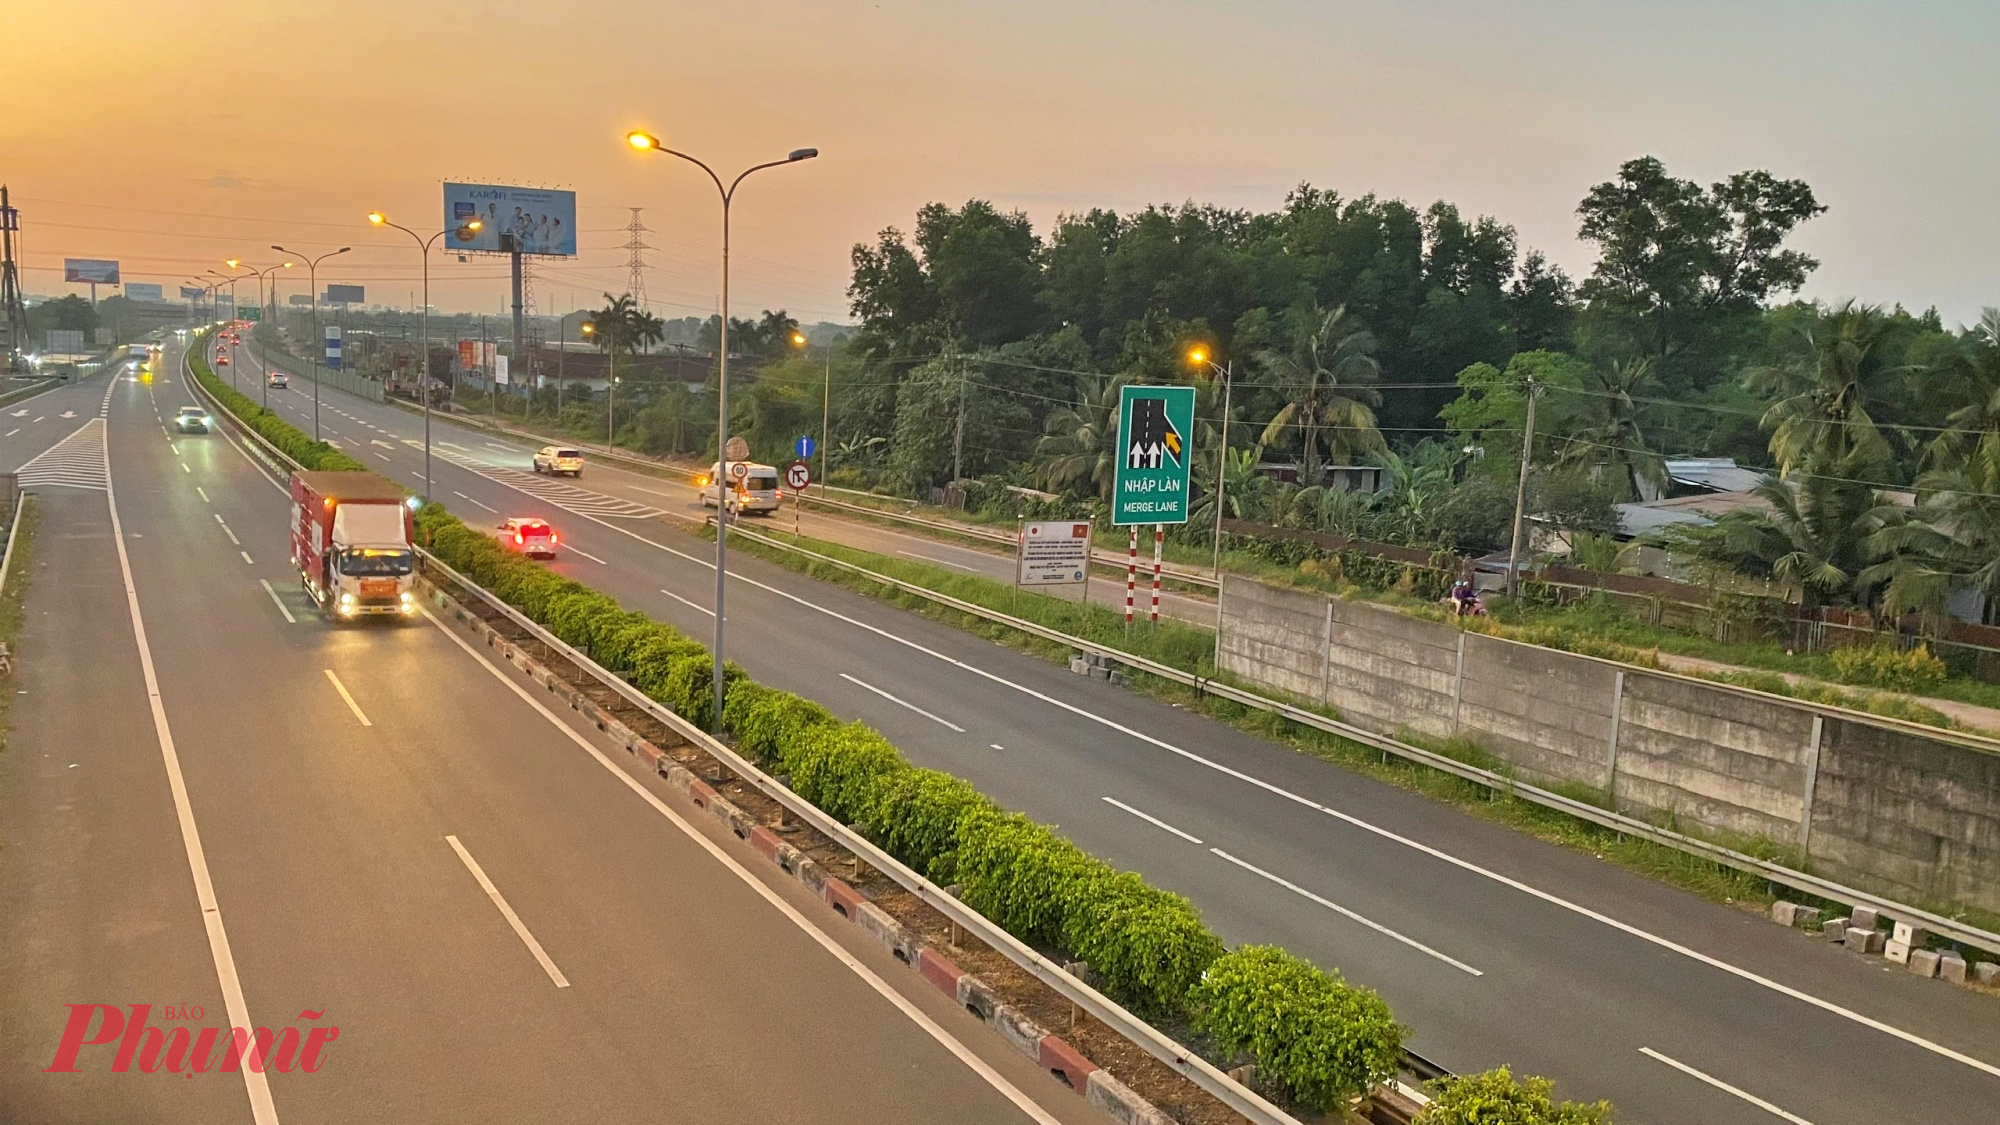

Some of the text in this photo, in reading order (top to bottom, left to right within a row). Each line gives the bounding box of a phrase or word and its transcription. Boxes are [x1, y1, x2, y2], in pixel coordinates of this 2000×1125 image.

[469, 189, 506, 201] KAROFI
[1124, 475, 1180, 494] NHẬP LÀN
[1123, 501, 1178, 513] MERGE LANE
